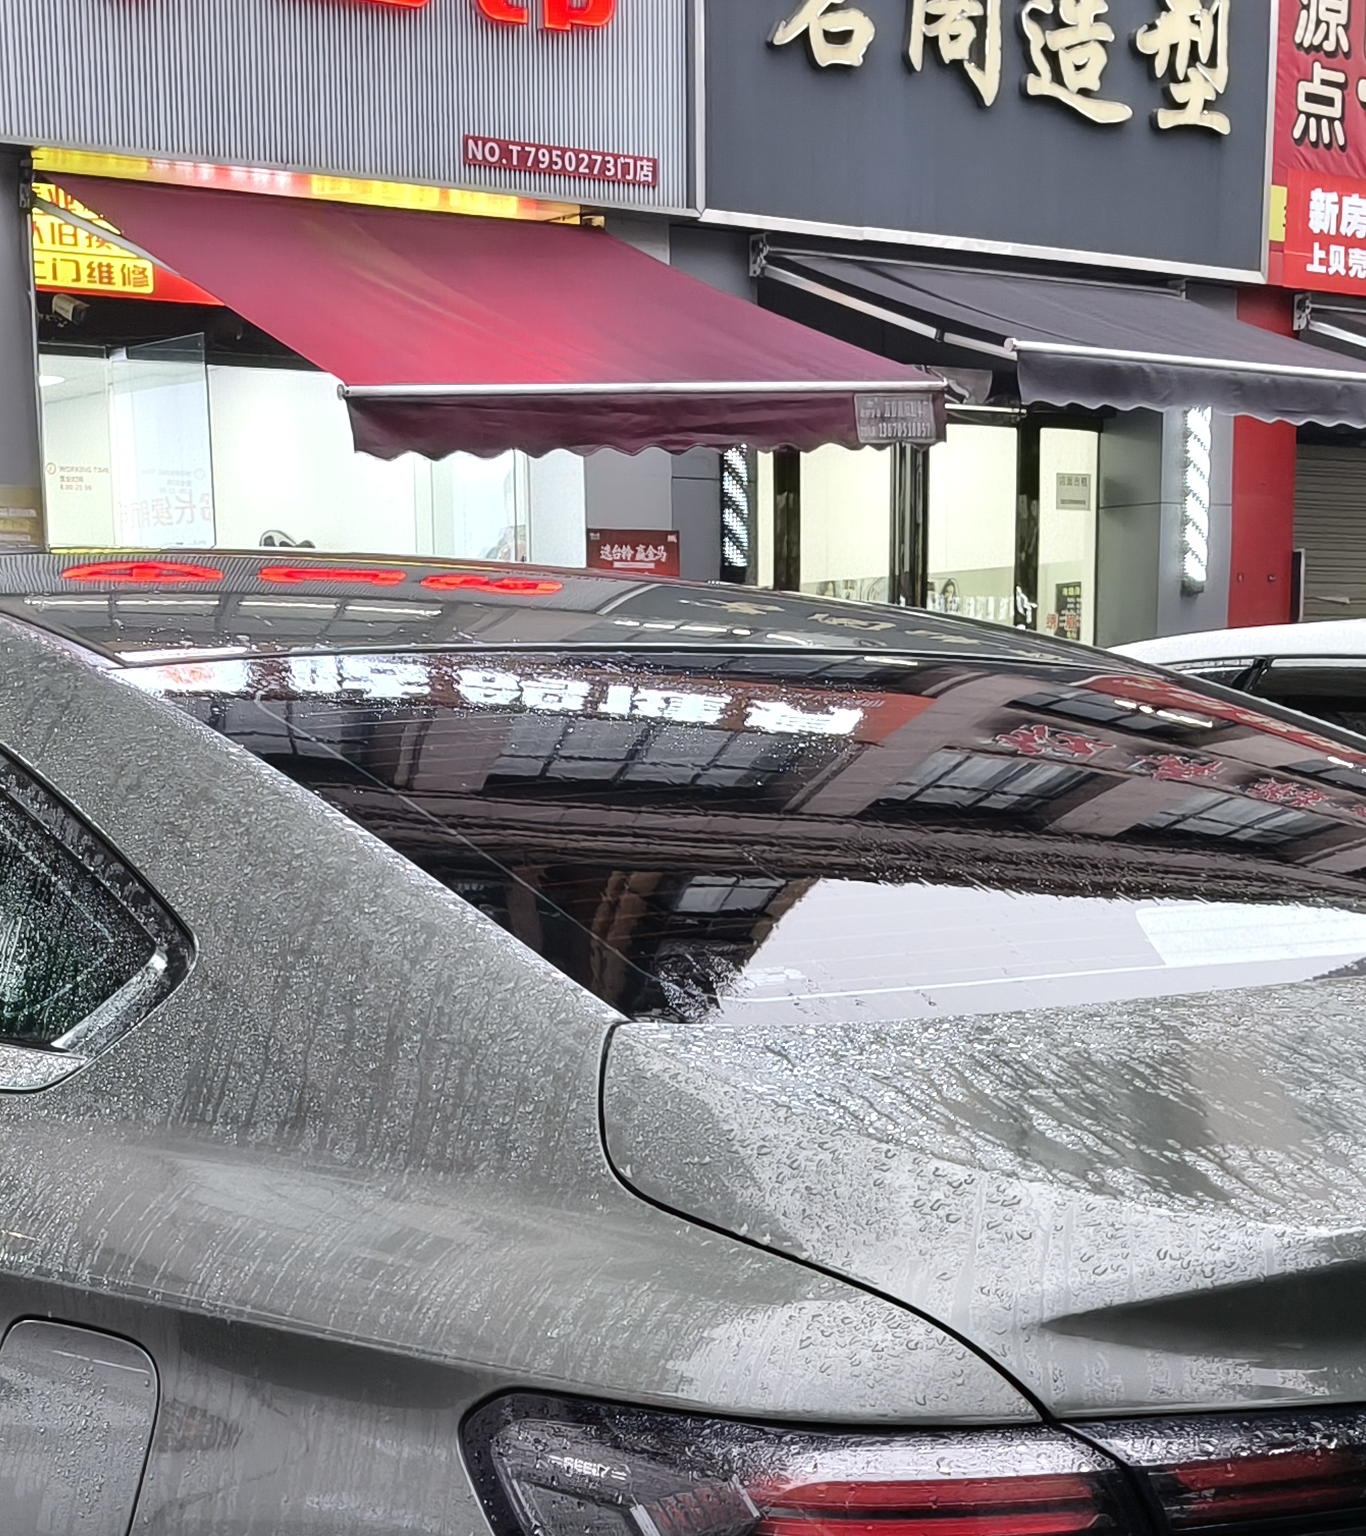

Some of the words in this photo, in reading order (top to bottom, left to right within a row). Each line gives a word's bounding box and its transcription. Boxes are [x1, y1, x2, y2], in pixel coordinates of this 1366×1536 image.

[467, 138, 654, 183] NO.T7950273门店
[600, 543, 634, 561] 选台铃
